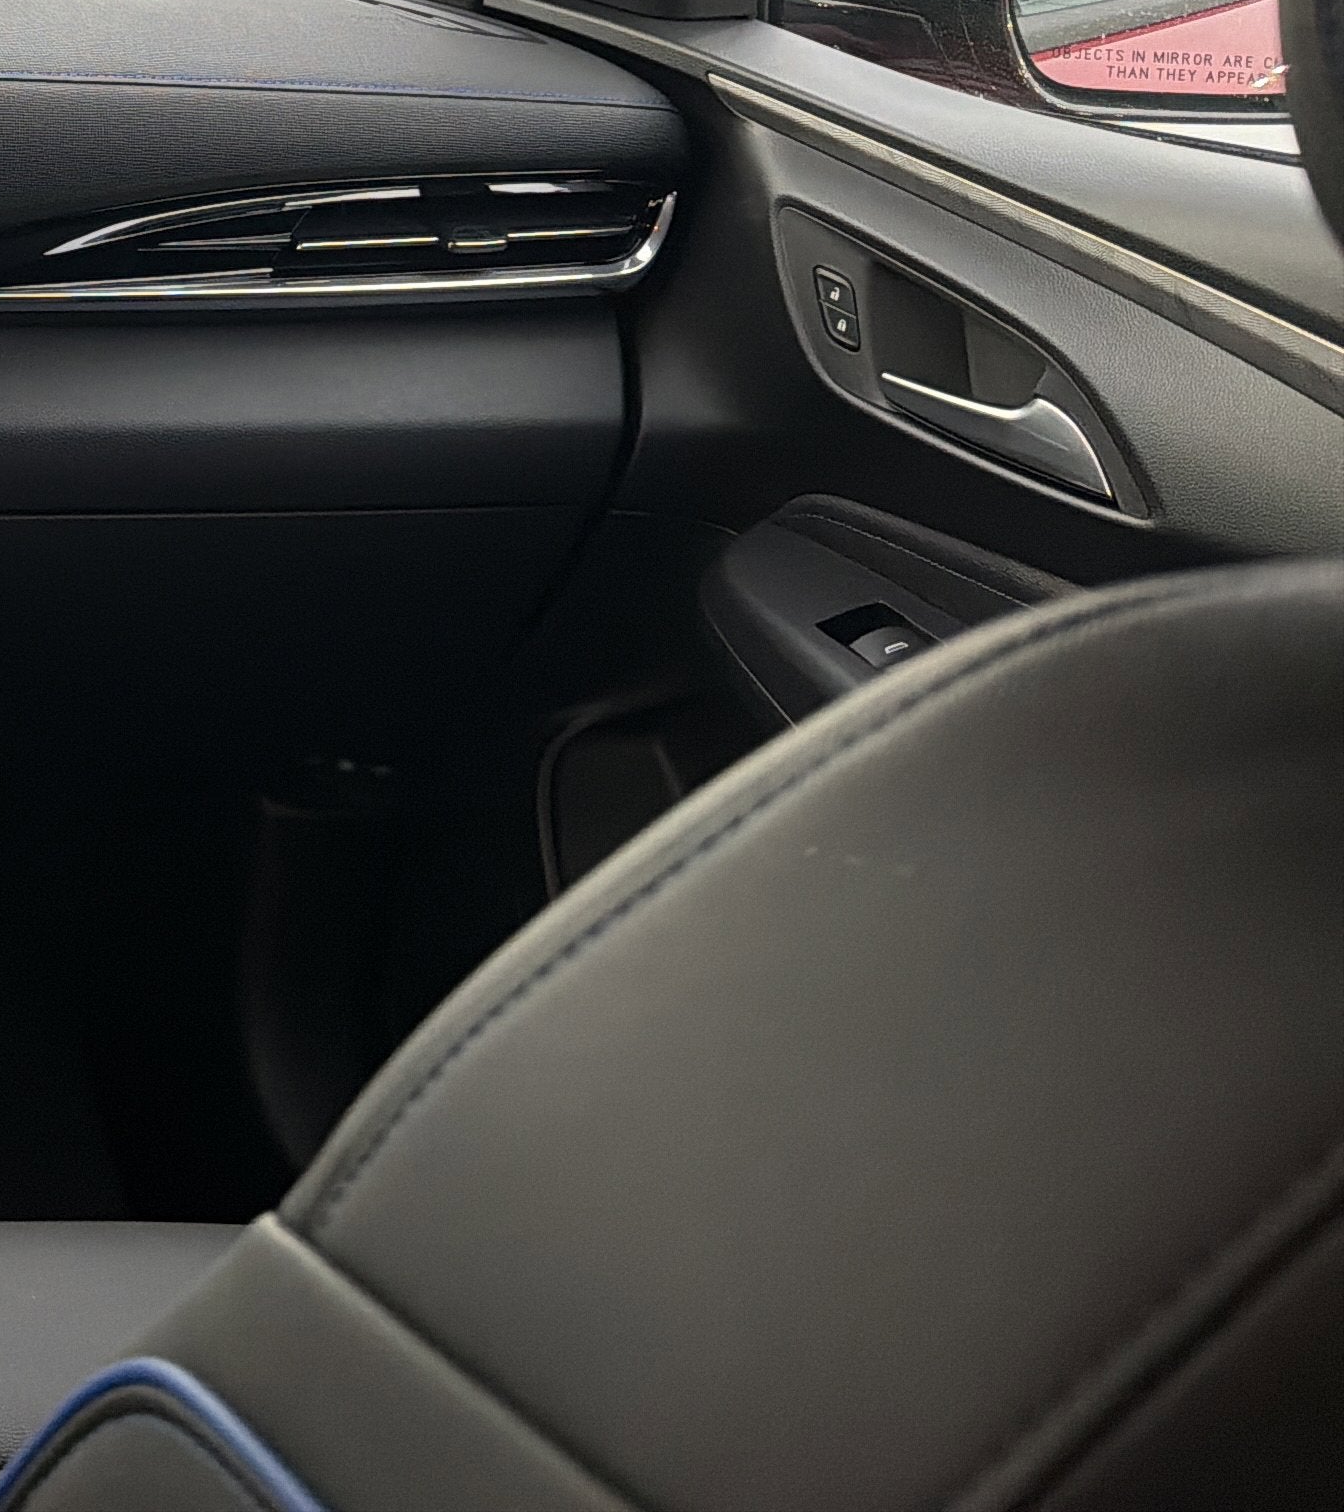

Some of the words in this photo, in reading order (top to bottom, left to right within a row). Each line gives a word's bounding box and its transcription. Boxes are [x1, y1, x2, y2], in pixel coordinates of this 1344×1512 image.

[1052, 47, 1124, 61] OBJECTS
[1131, 50, 1146, 63] IN
[1153, 51, 1213, 66] MIRROR
[1223, 55, 1253, 69] ARE
[1106, 65, 1149, 79] THAN
[1156, 67, 1197, 82] THEY
